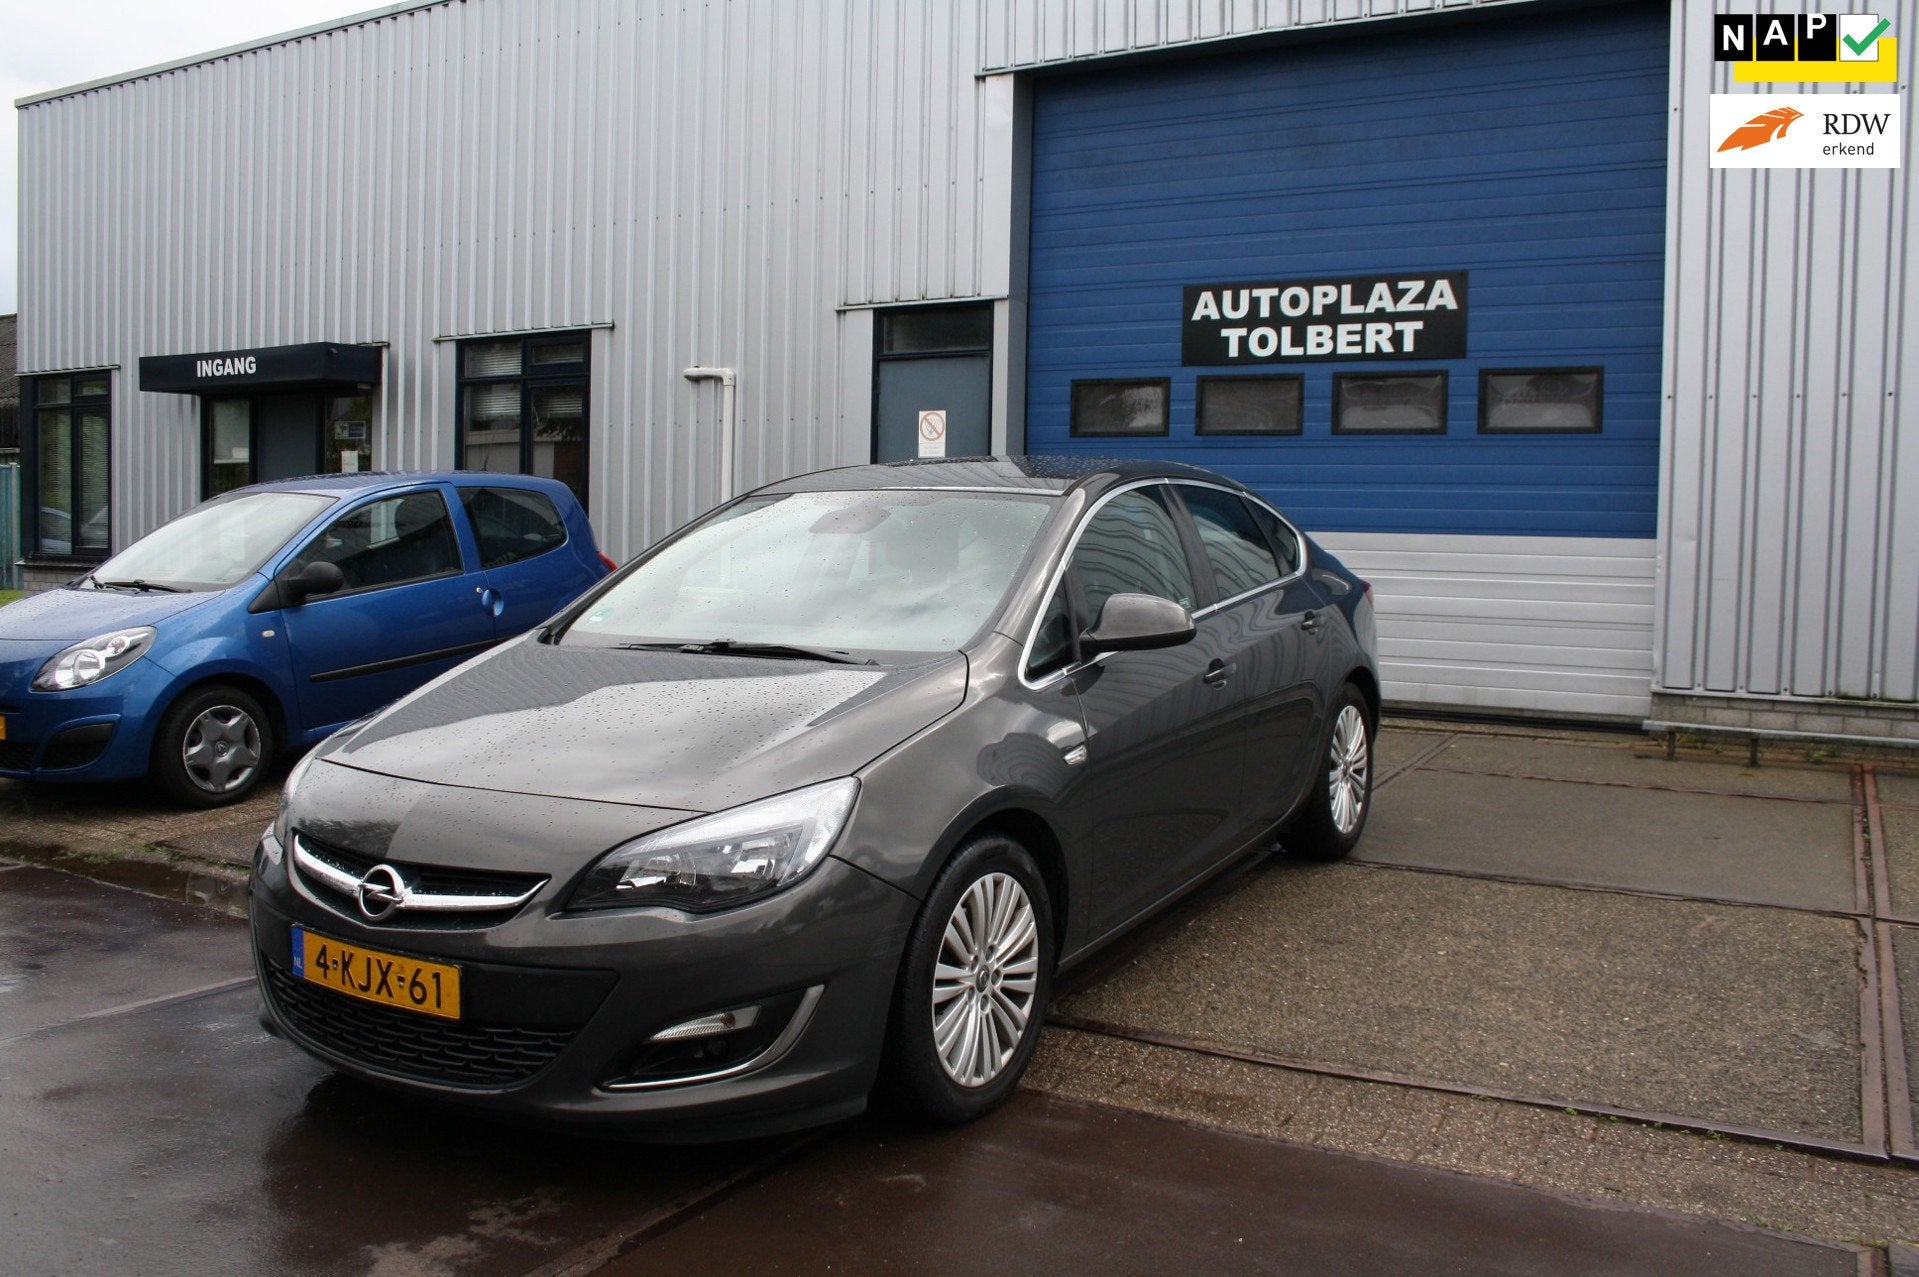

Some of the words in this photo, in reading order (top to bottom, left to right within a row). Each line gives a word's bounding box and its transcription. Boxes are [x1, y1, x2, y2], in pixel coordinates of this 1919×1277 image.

[1191, 279, 1458, 321] AUTOPLAZA
[1221, 321, 1424, 358] TOLBERT
[196, 356, 257, 378] INGANG
[293, 955, 303, 969] NL
[315, 943, 442, 1009] 4-KJX-61
